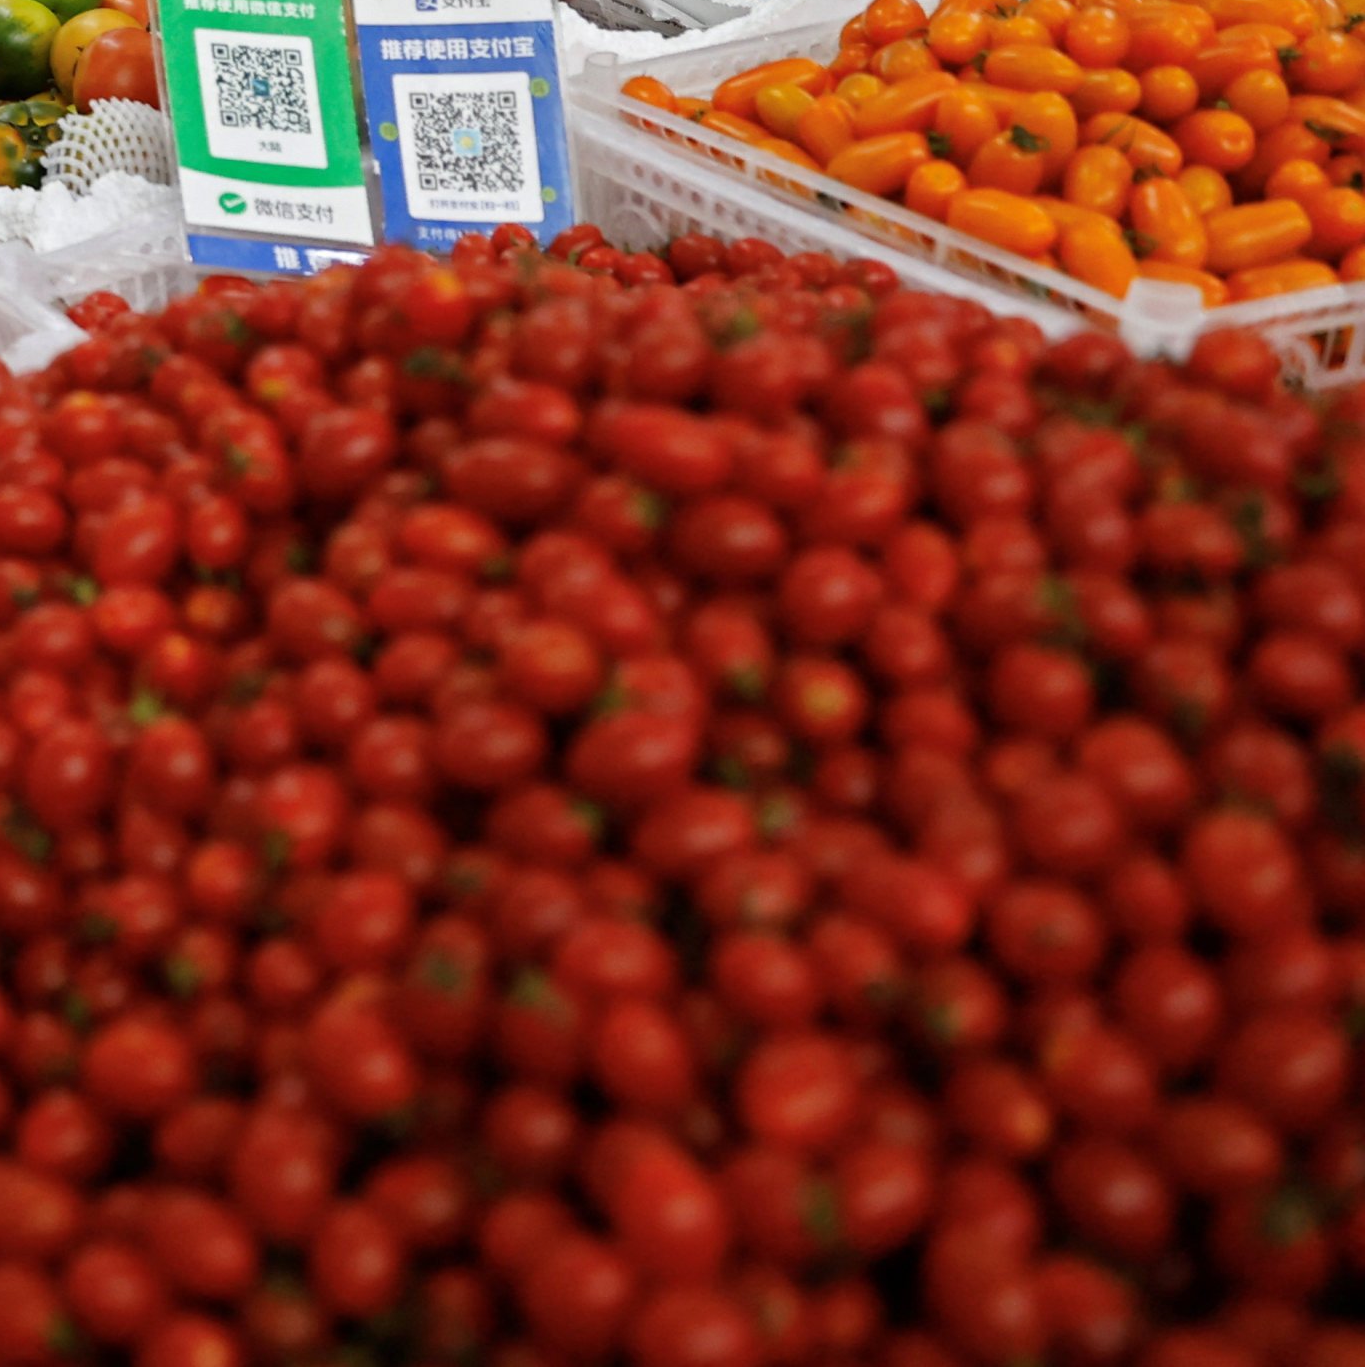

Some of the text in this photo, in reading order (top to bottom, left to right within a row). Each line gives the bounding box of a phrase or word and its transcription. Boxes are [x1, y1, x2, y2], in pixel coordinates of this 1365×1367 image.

[379, 37, 535, 61] 推荐使用支付宝
[253, 197, 335, 224] 微信支付
